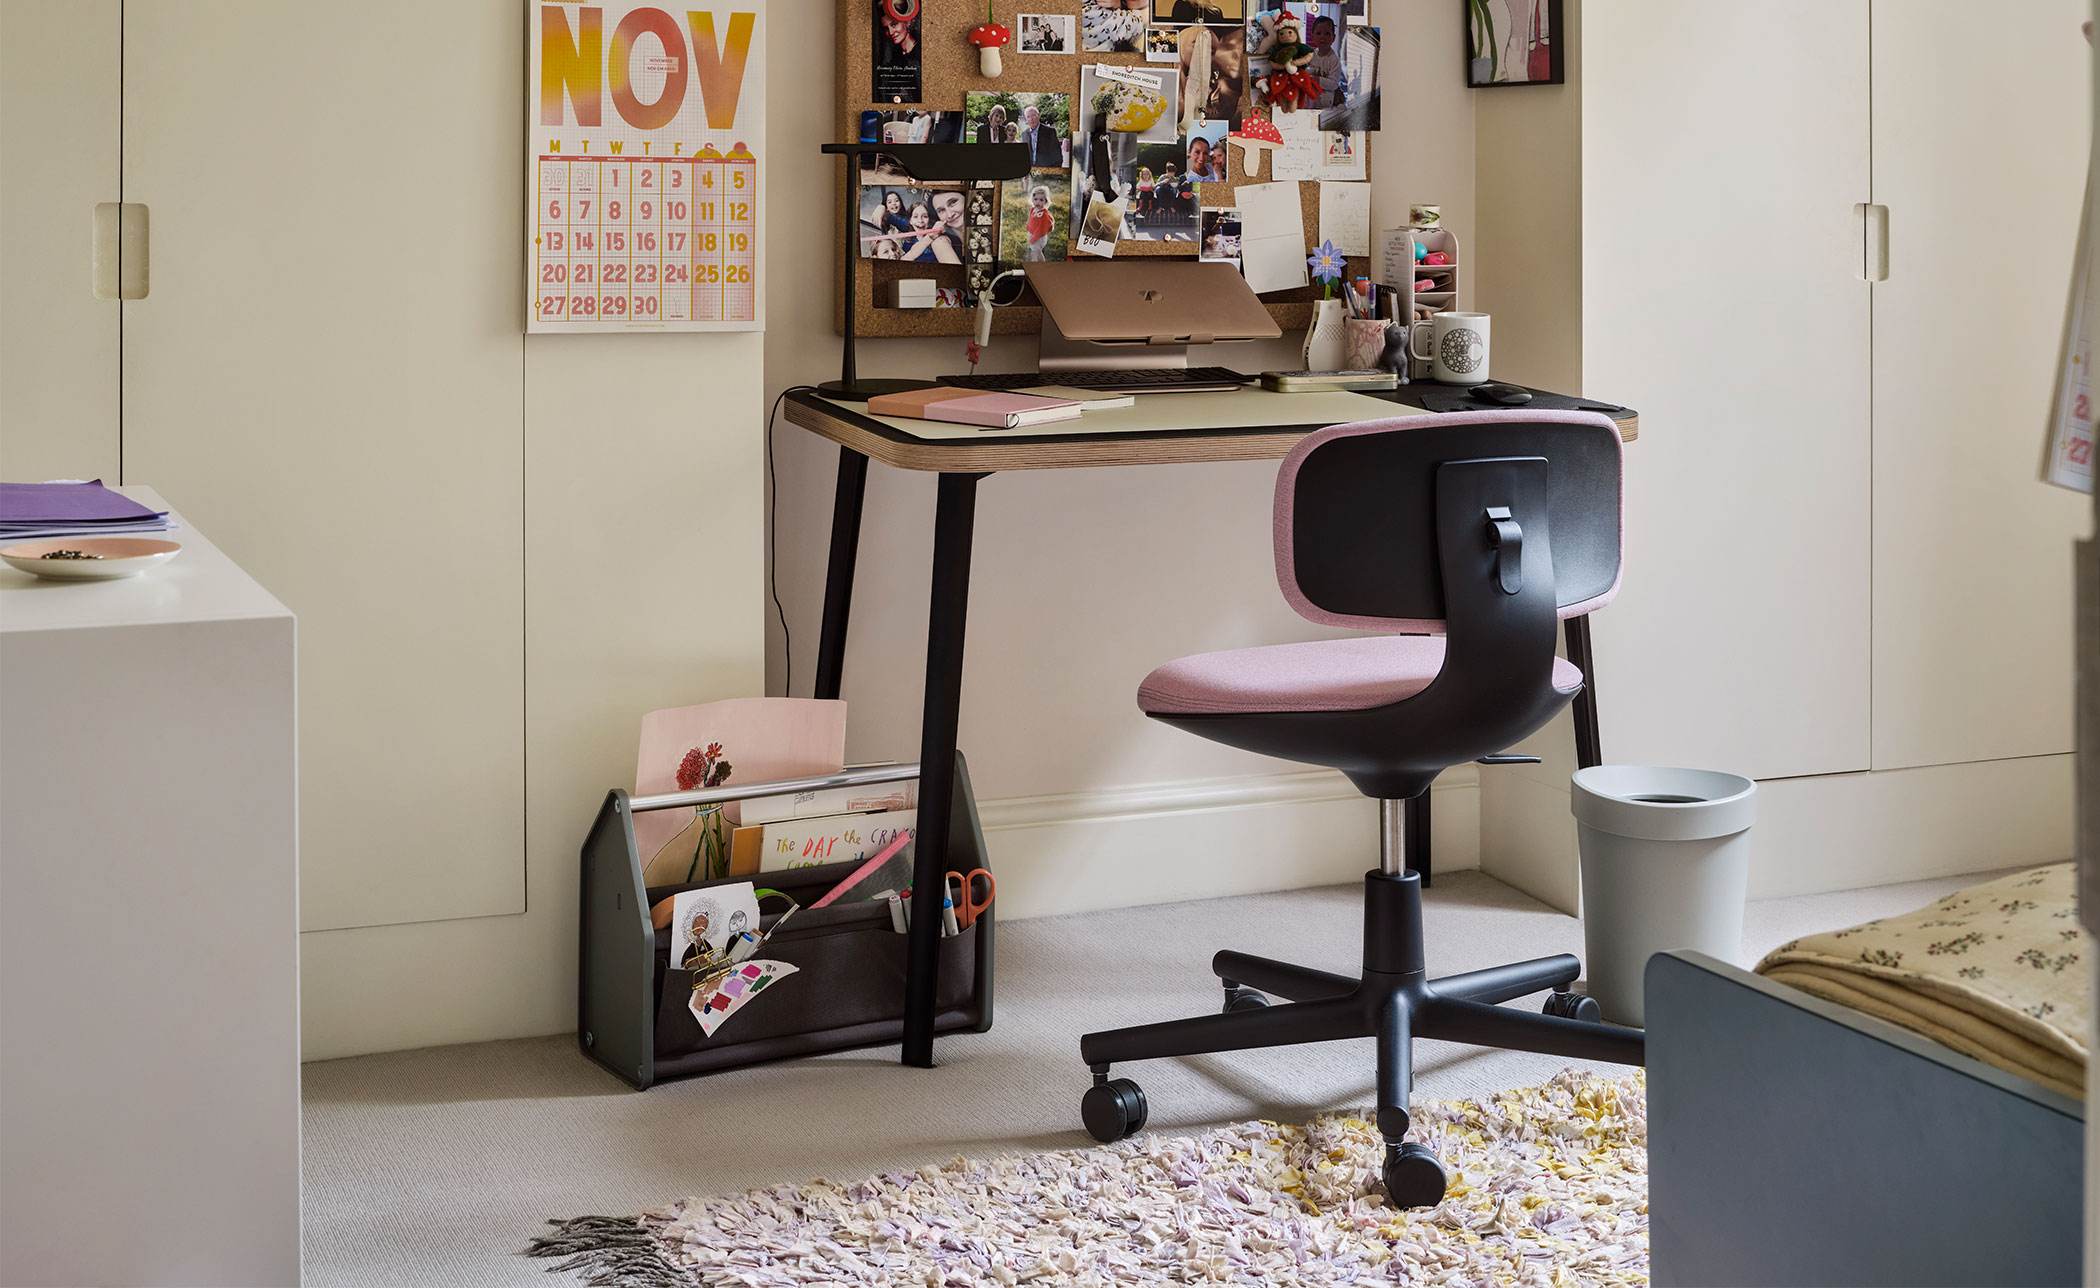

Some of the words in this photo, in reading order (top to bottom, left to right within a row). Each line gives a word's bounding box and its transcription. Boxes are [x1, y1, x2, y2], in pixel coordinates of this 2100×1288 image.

[541, 6, 756, 130] NOV
[1112, 70, 1141, 81] SHOREDITCH
[550, 139, 561, 153] M
[581, 140, 590, 154] T
[609, 141, 624, 155] W
[643, 142, 651, 155] T
[674, 142, 683, 156] F
[704, 142, 714, 156] S
[612, 169, 618, 187] 1
[641, 169, 652, 188] 2
[672, 170, 682, 188] 3
[702, 171, 714, 189] 4
[733, 171, 745, 190] 5
[549, 201, 561, 219] 6
[579, 201, 591, 219] 7
[609, 201, 621, 220] 8
[640, 202, 652, 220] 9
[668, 202, 687, 220] 10
[700, 202, 715, 221] 11
[729, 202, 748, 221] 12
[546, 232, 564, 251] 13
[575, 232, 594, 250] 14
[606, 232, 625, 251] 15
[636, 233, 656, 251] 16
[667, 233, 687, 251] 17
[697, 233, 717, 252] 18
[729, 233, 748, 252] 19
[542, 264, 567, 283] 20
[574, 264, 593, 283] 21
[602, 264, 627, 283] 22
[634, 264, 657, 283] 23
[664, 264, 688, 283] 24
[695, 264, 719, 284] 25
[726, 265, 751, 284] 26
[542, 296, 566, 315] 27
[571, 296, 596, 315] 28
[602, 296, 627, 315] 29
[634, 296, 658, 315] 30
[2069, 437, 2090, 465] 27
[776, 837, 796, 853] The
[802, 836, 839, 858] DAY
[844, 829, 861, 844] the
